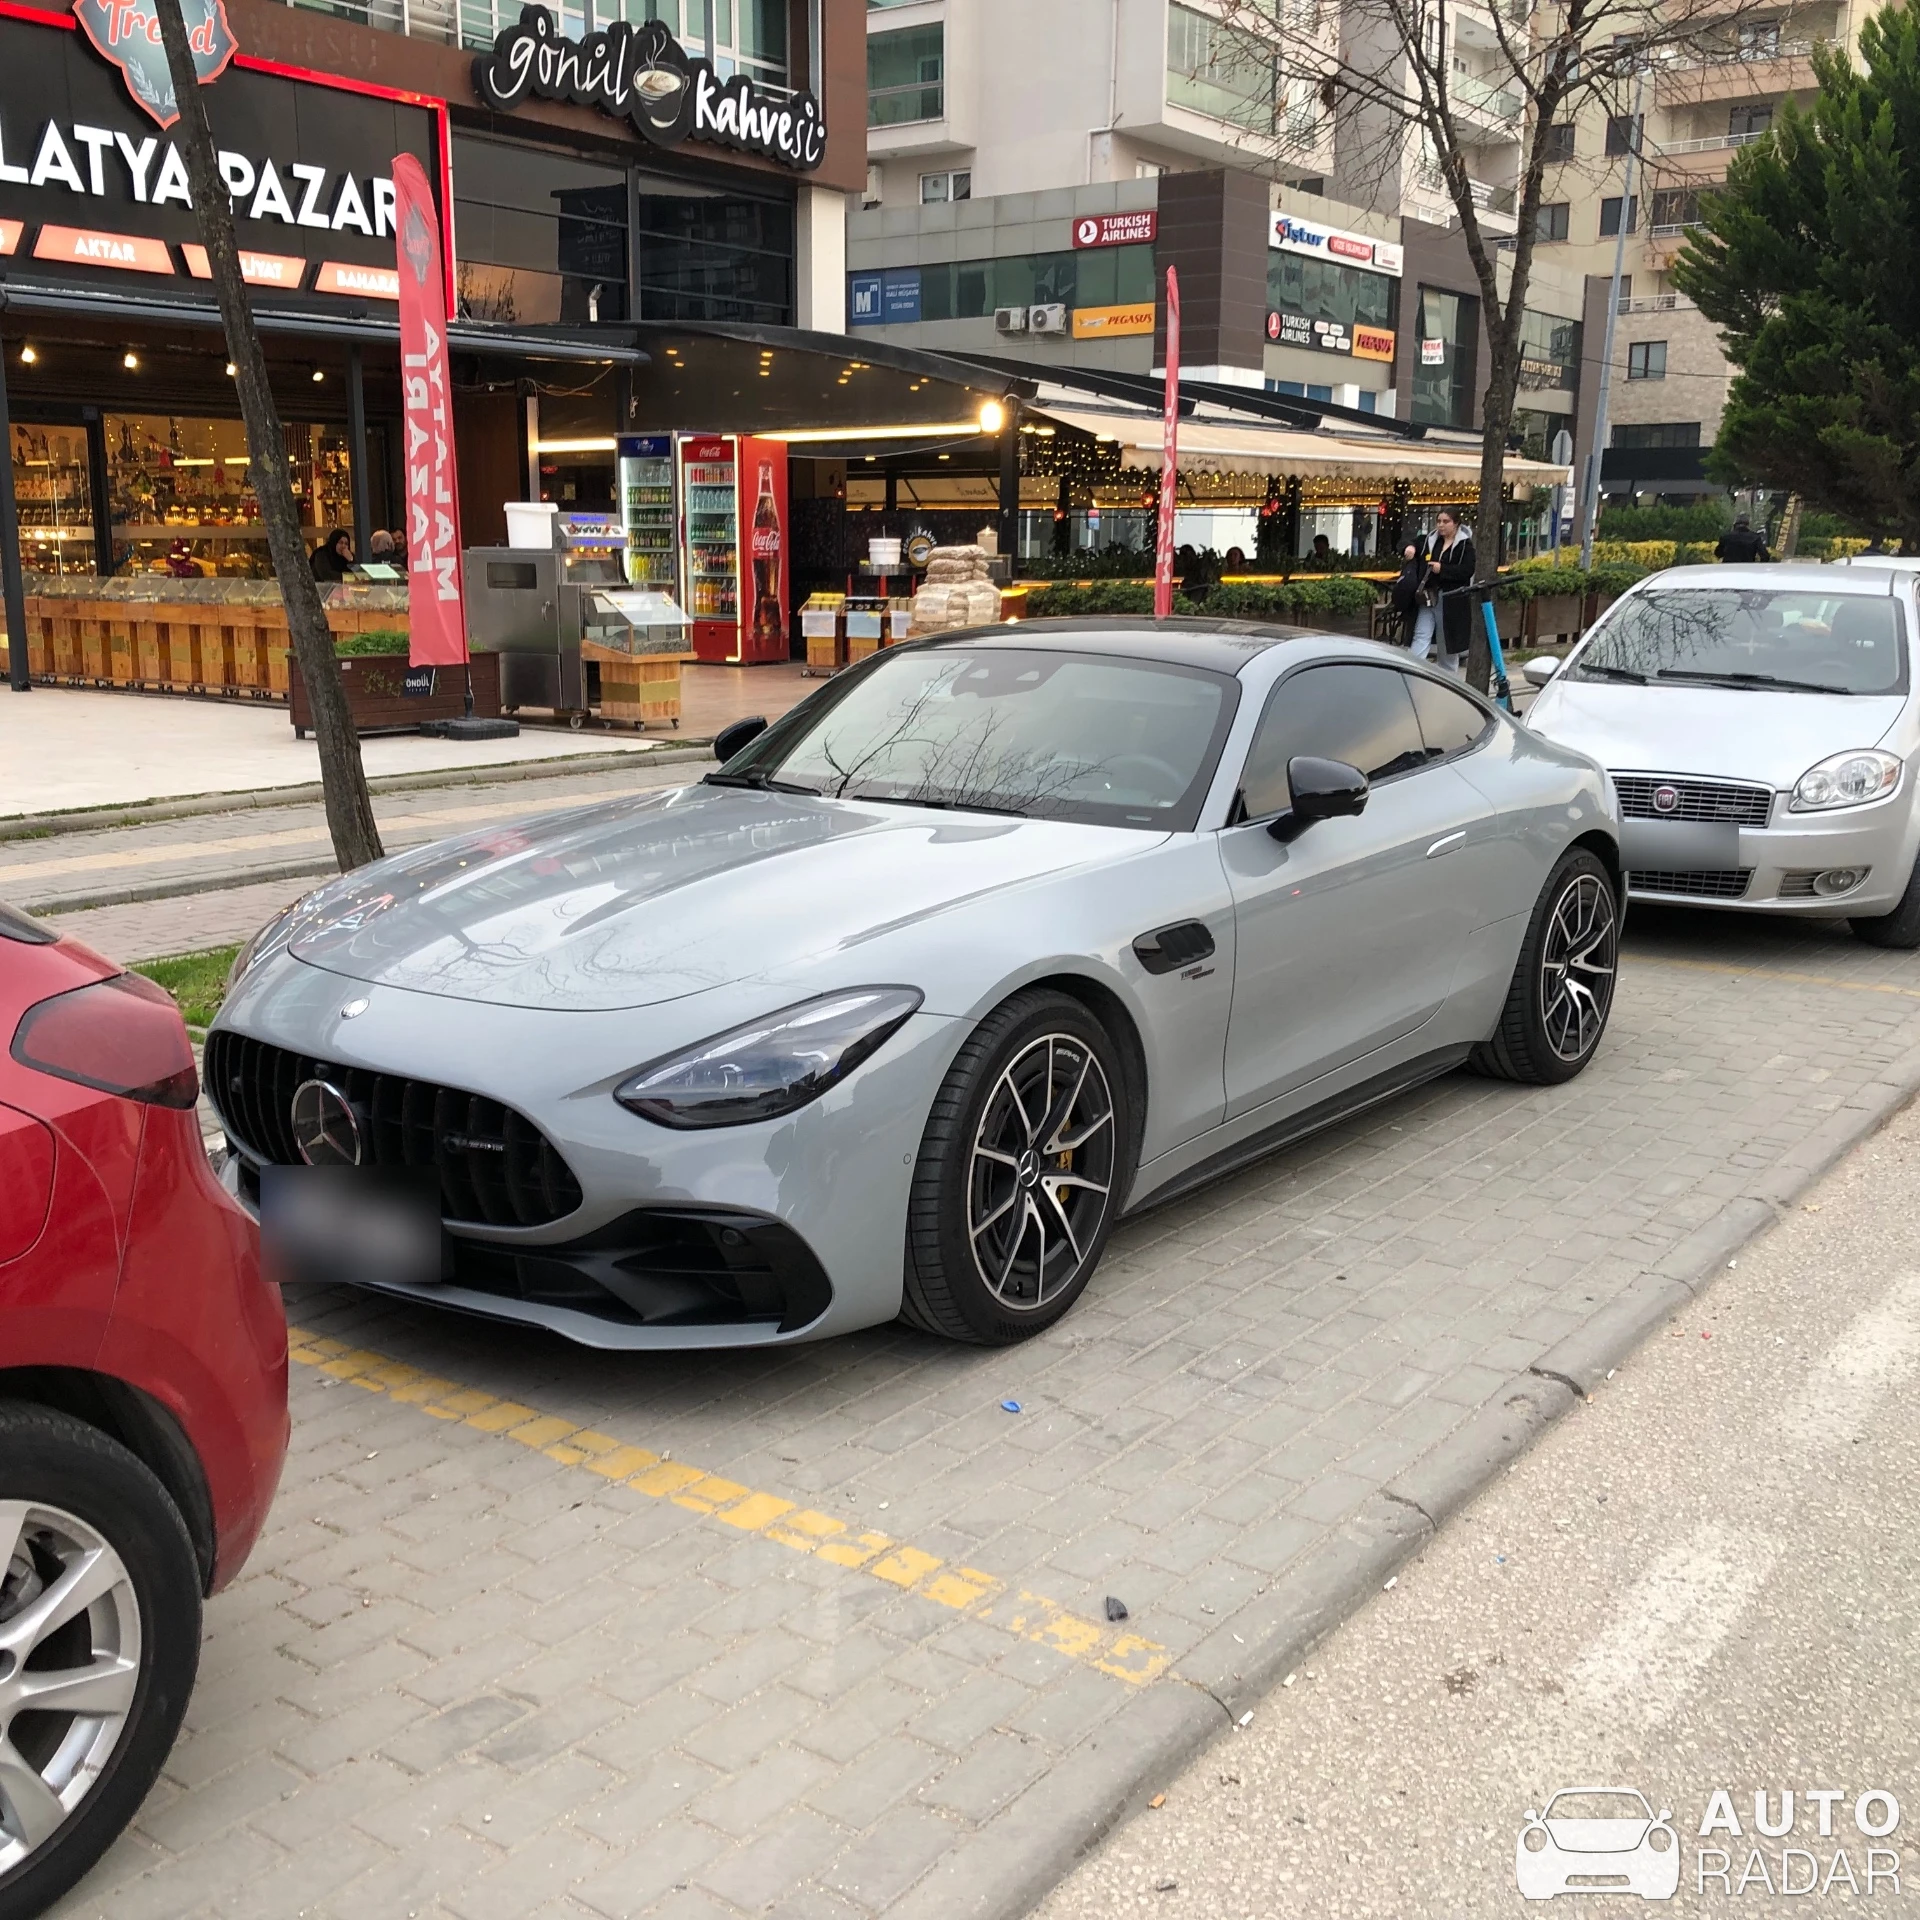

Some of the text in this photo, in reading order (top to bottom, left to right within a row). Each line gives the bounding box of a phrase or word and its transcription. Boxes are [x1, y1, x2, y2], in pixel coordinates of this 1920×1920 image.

[98, 0, 216, 55] Tred
[696, 69, 824, 163] kahvesi
[1101, 214, 1151, 229] TURKISH
[1101, 226, 1151, 243] AIRLINES
[74, 236, 136, 262] AKTAR
[240, 258, 283, 281] LİYAT
[336, 268, 399, 295] BAHARA
[1107, 312, 1152, 326] PEGASUS
[1282, 313, 1311, 331] TURKISH
[1280, 328, 1311, 344] AIRLINES
[752, 530, 780, 551] Coca-Cola
[1657, 793, 1674, 806] FIAT
